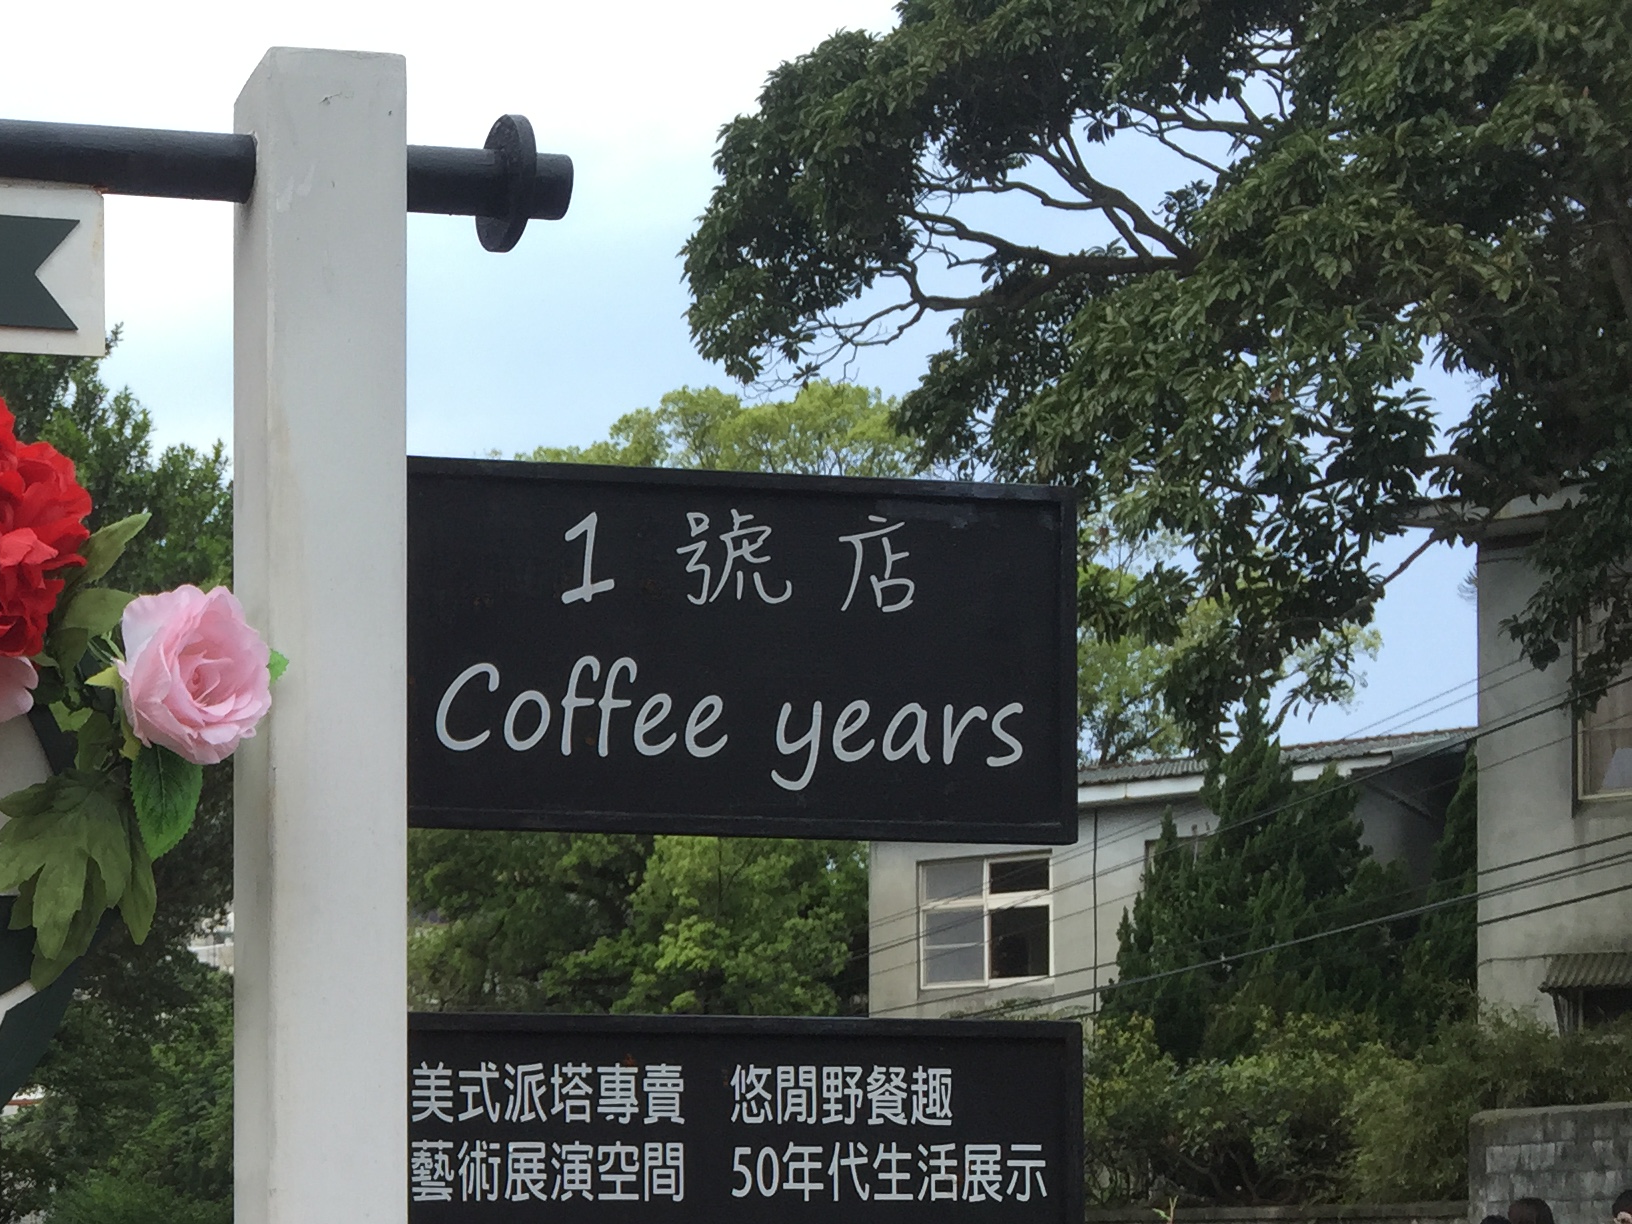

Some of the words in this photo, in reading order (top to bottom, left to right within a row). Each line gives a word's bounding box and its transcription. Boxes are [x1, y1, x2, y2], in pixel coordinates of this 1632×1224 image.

[436, 655, 728, 758] Coffee
[771, 698, 1024, 791] years
[410, 1062, 685, 1126] 美式派塔專賣
[730, 1064, 954, 1127] 悠閒野餐趣
[410, 1140, 685, 1203] 藝術展演空間
[731, 1141, 1048, 1203] 50年代生活展示
